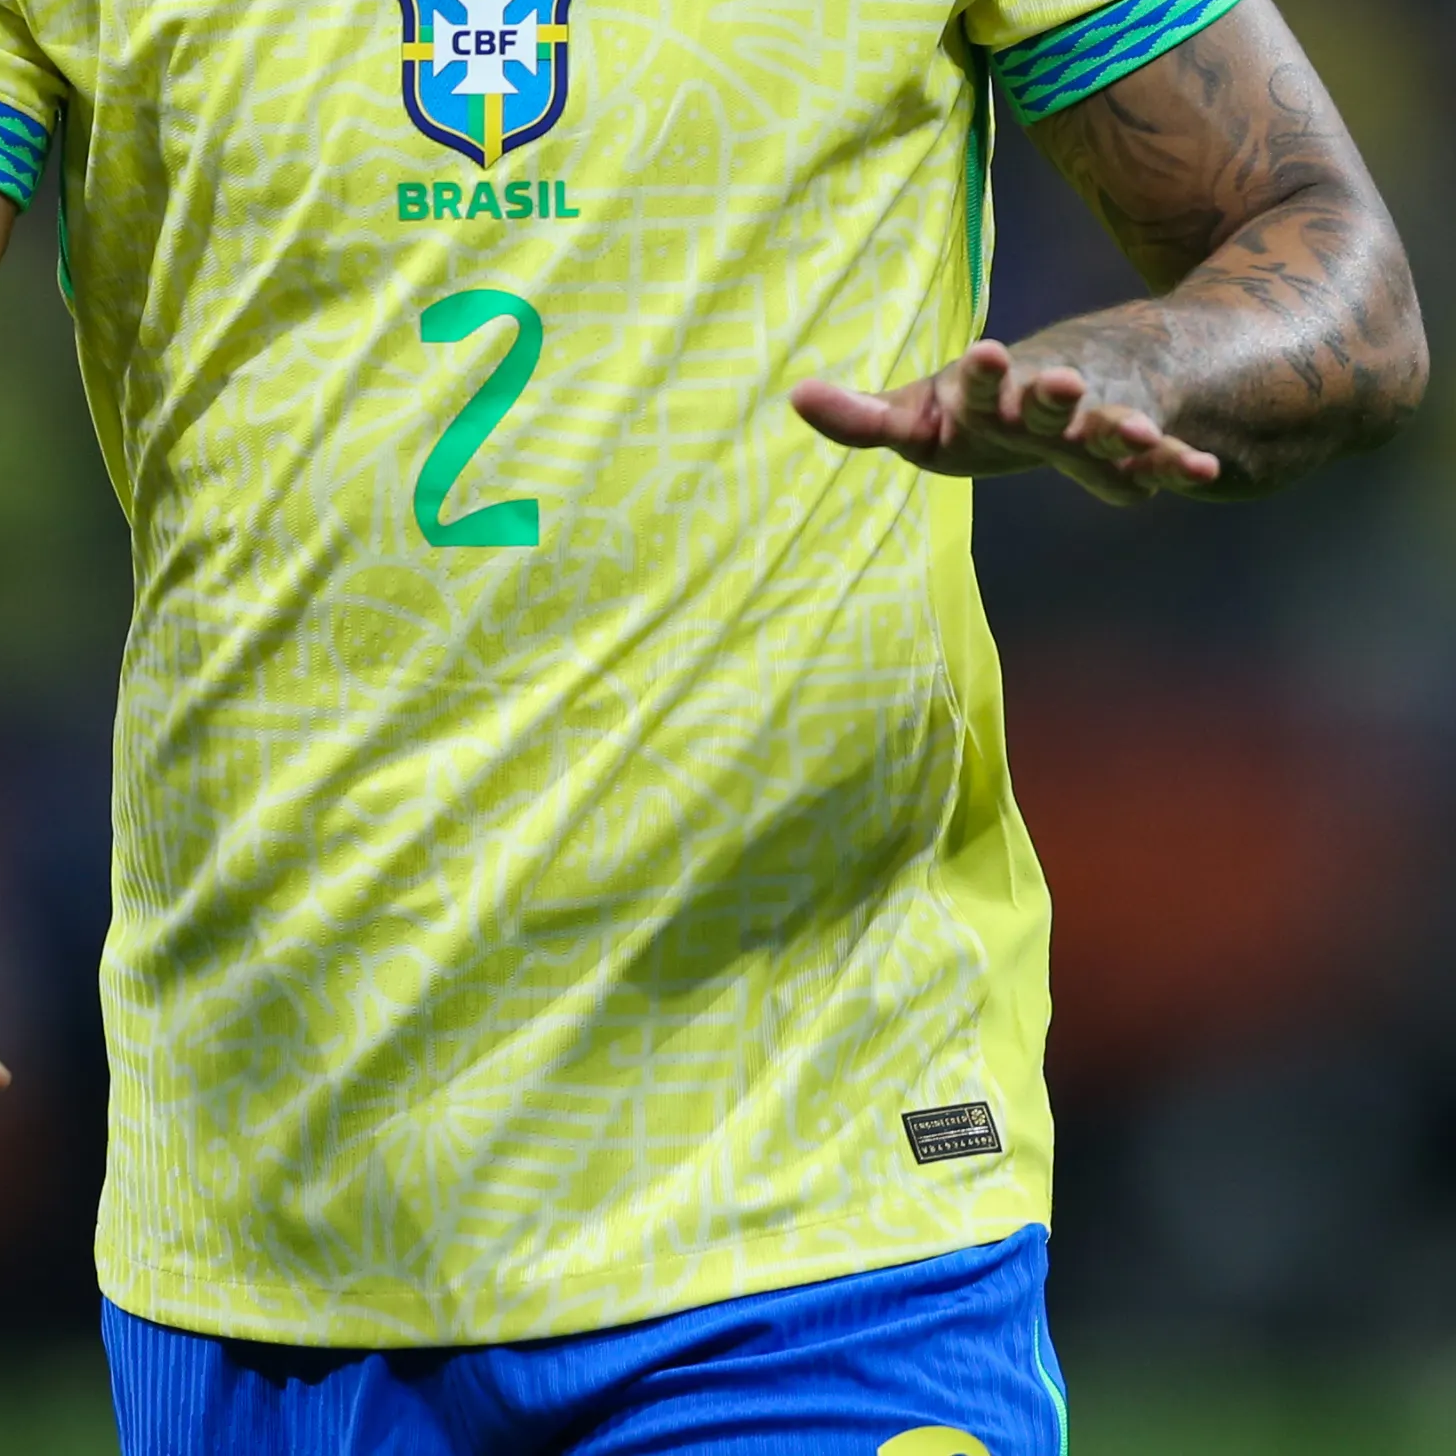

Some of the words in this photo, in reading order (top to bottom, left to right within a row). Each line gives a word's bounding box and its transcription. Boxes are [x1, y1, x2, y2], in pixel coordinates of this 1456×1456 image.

[452, 30, 518, 55] CBF
[397, 180, 581, 221] BRASIL
[413, 289, 543, 547] 2
